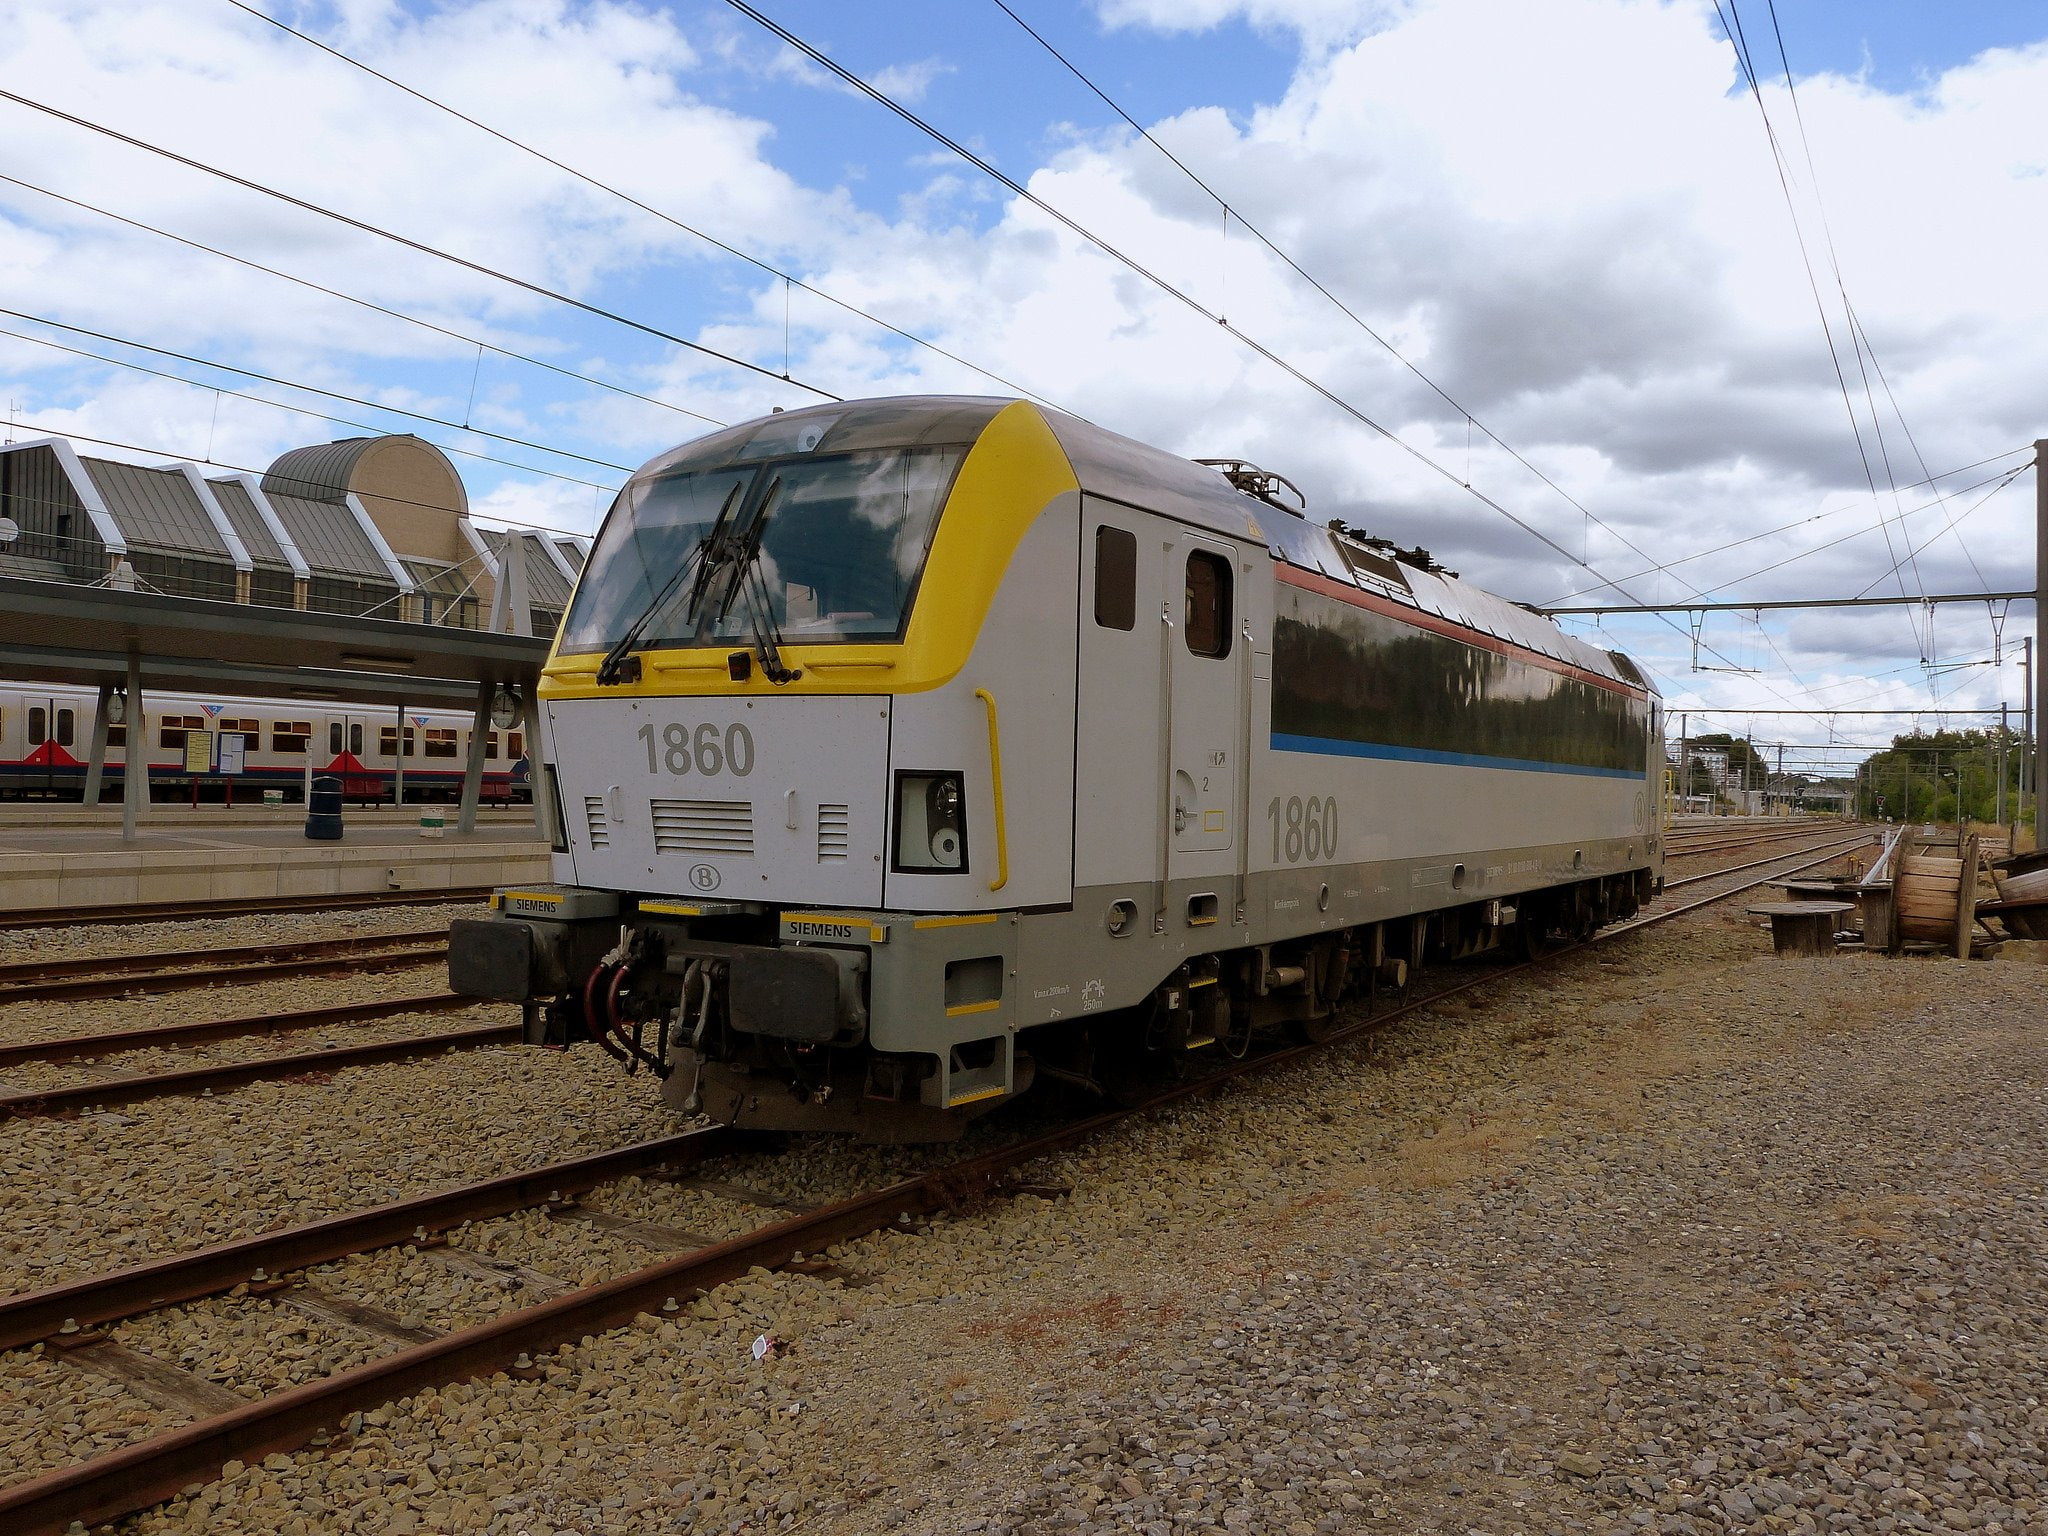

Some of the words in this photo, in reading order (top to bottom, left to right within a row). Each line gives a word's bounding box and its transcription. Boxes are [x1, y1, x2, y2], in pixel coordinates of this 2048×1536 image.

[638, 723, 754, 777] 1860
[1203, 776, 1209, 792] 2
[1267, 795, 1338, 864] 1860
[516, 899, 557, 913] SIEMENS
[790, 921, 852, 938] SIEMENS
[1083, 999, 1103, 1011] 250m
